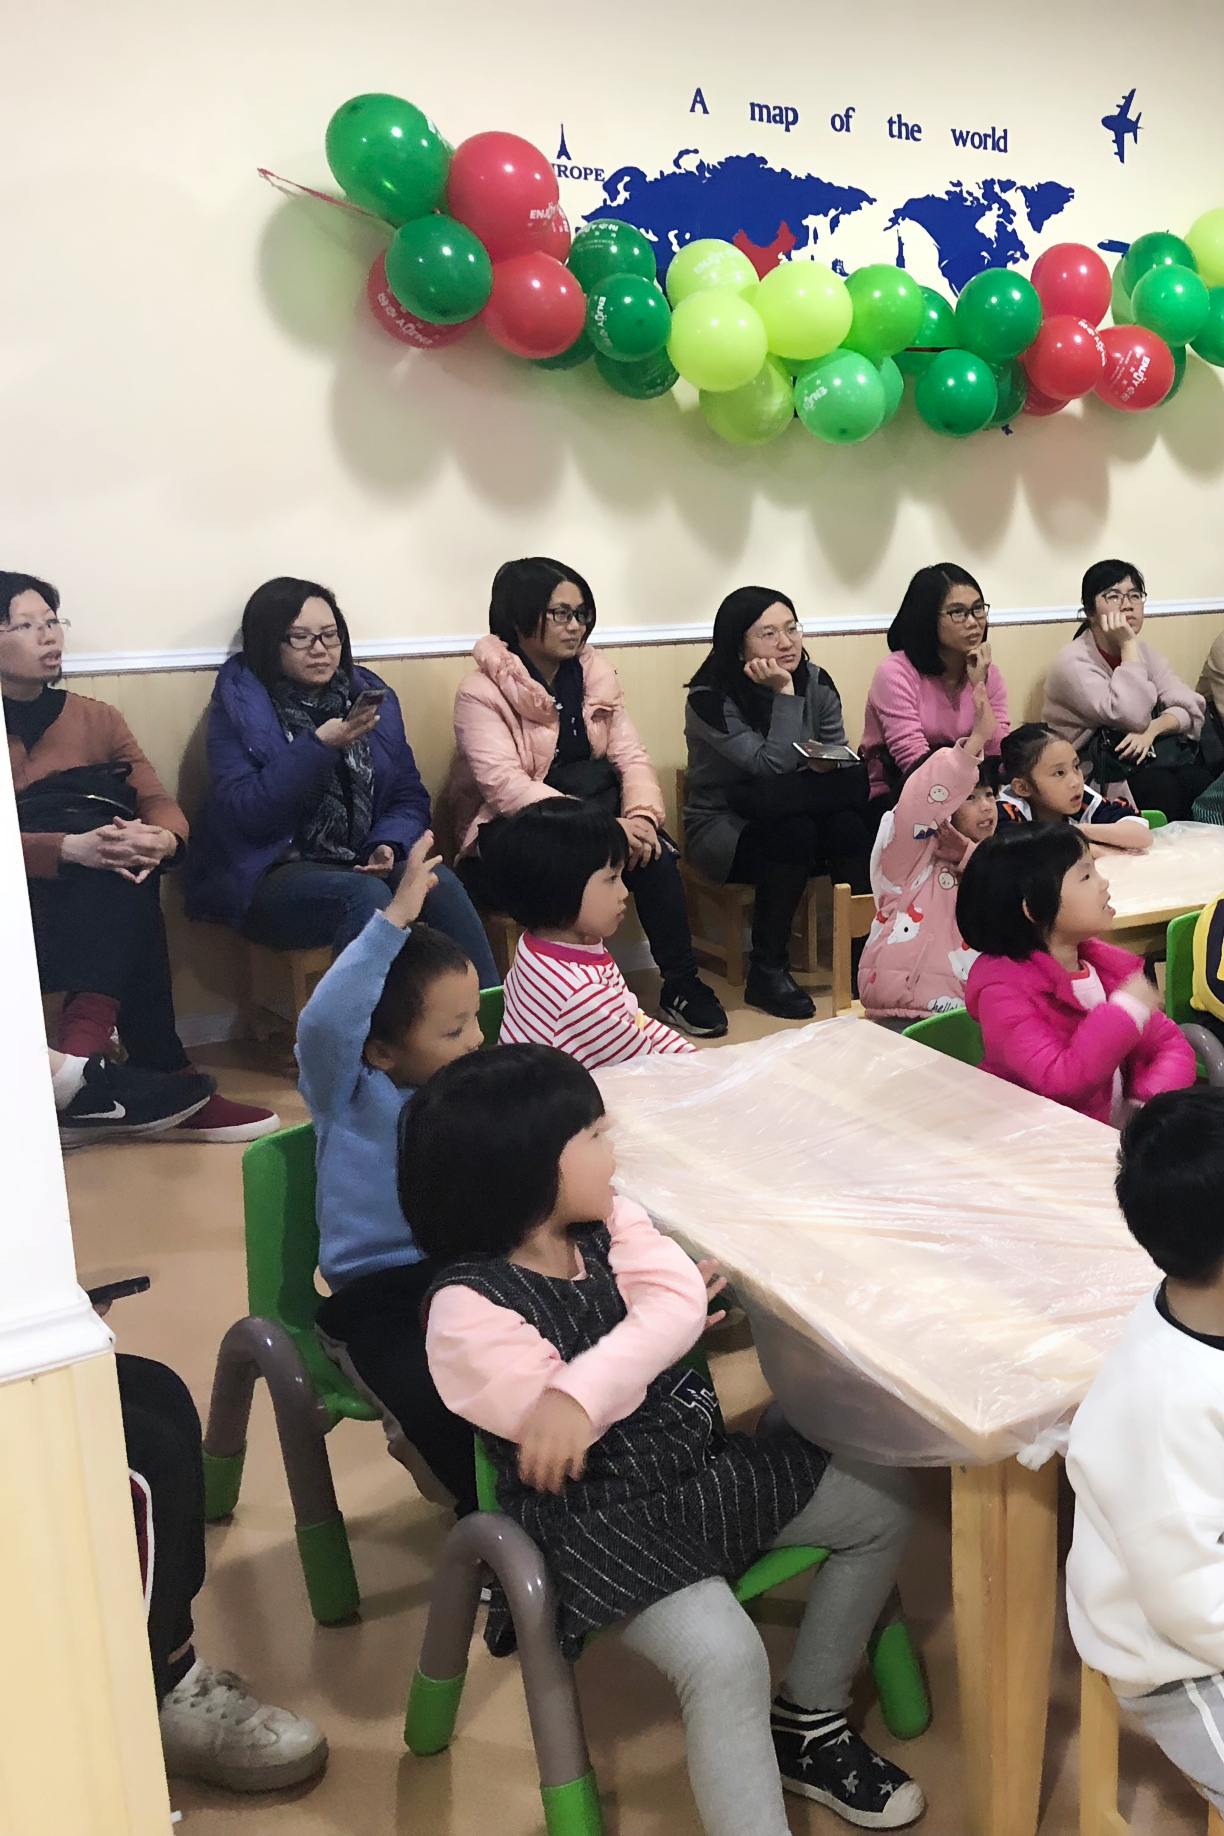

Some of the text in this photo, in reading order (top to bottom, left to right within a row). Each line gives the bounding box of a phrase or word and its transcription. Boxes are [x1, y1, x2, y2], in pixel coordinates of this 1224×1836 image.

[690, 87, 1008, 153] A map of the world
